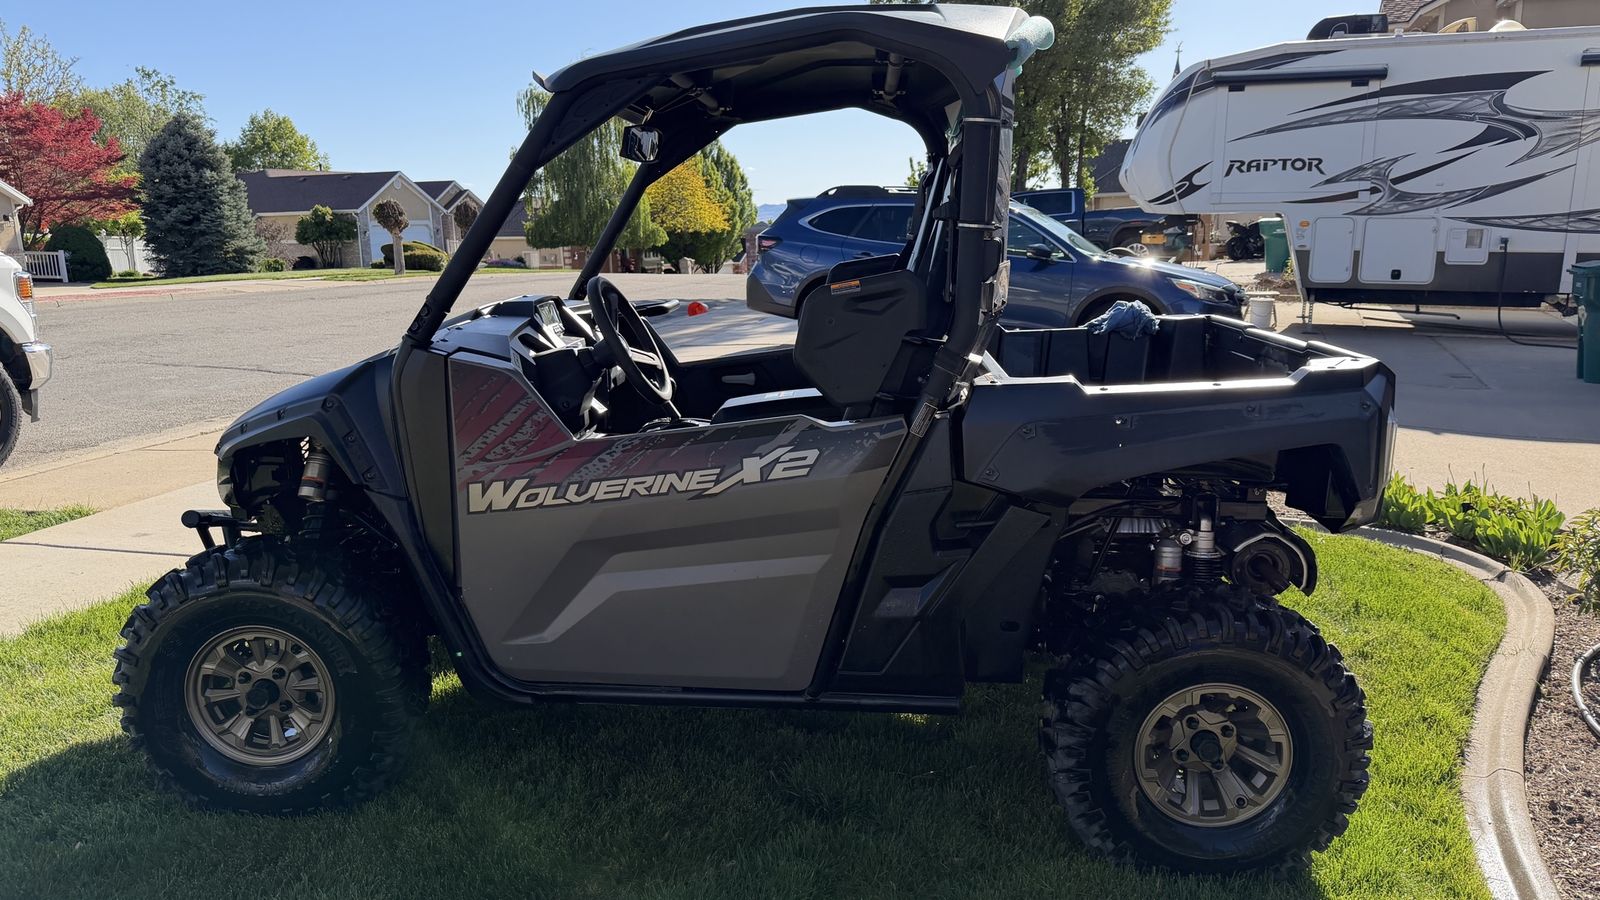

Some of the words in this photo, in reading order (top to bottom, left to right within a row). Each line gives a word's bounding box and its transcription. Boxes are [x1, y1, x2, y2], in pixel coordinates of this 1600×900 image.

[1224, 158, 1326, 178] RAPTOR
[467, 469, 721, 513] WOLVERINE
[703, 446, 820, 496] X2
